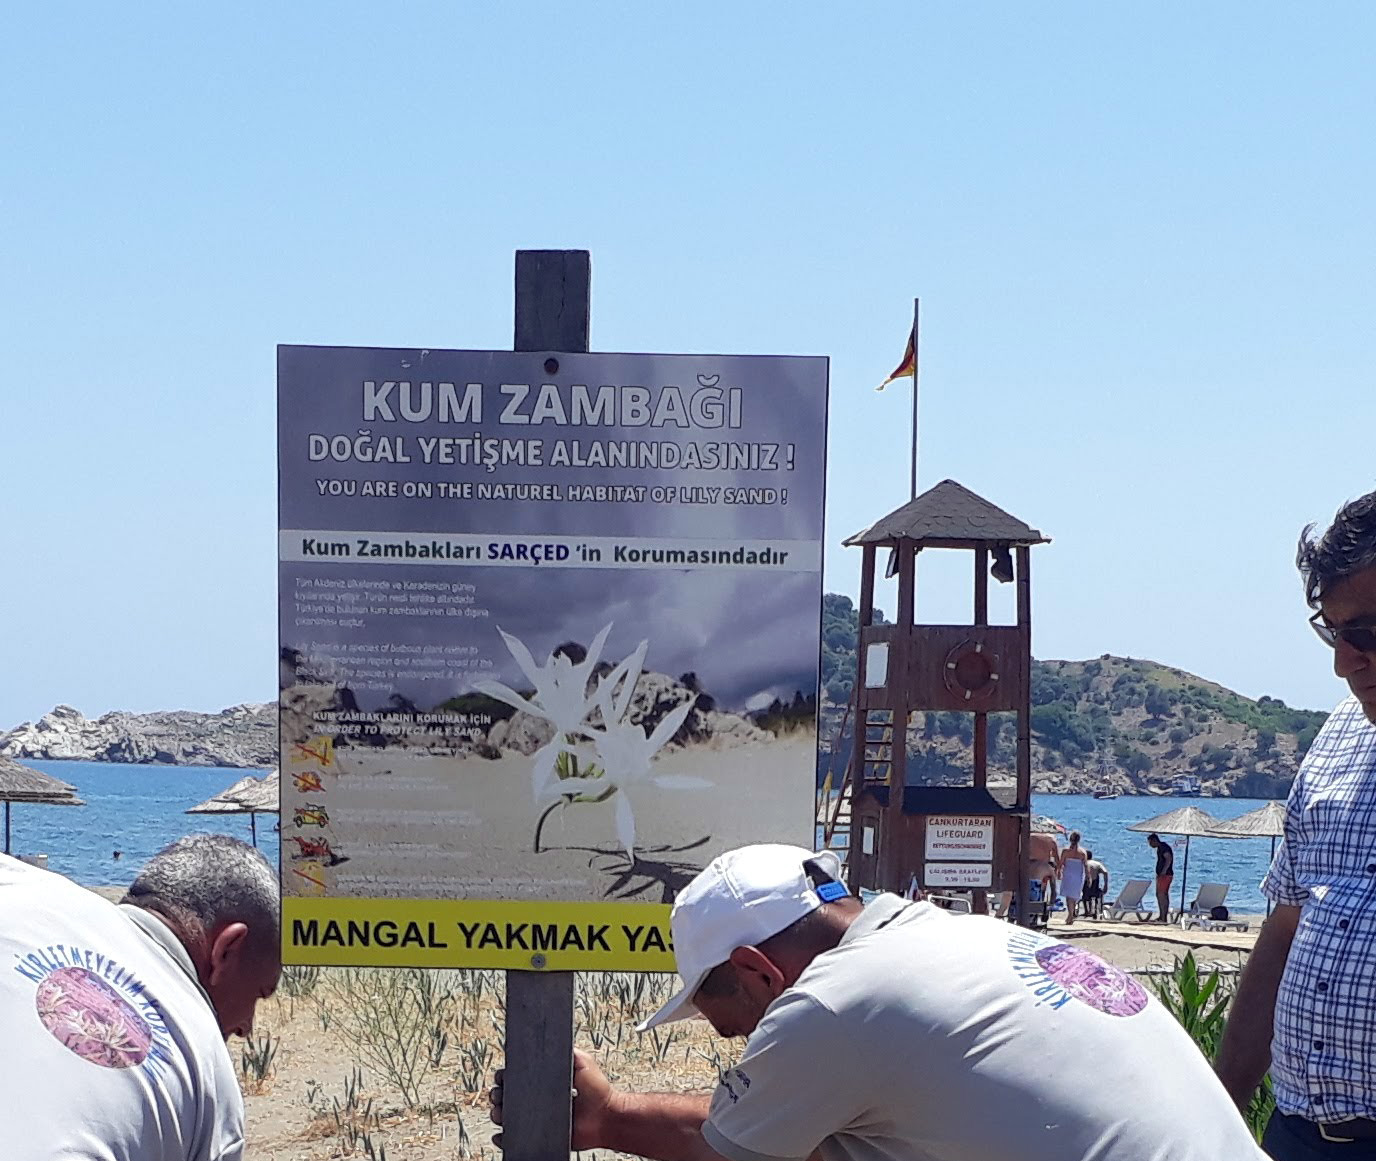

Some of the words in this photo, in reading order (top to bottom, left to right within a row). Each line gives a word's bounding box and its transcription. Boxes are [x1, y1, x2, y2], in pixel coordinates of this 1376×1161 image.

[363, 380, 483, 423] KUM
[499, 374, 743, 428] ZAMBAĞI
[308, 429, 411, 462] DOĞAL
[417, 432, 543, 473] YETİŞME
[549, 439, 780, 470] ALANINDASINIZ
[787, 443, 795, 470] !
[316, 480, 356, 496] YOU
[361, 481, 398, 497] ARE
[402, 482, 433, 498] ON
[437, 483, 472, 499] THE
[477, 483, 563, 500] NATUREL
[567, 485, 647, 502] HABITAT
[650, 486, 676, 503] OF
[679, 486, 721, 504] LILY
[723, 487, 777, 505] SAND
[781, 489, 788, 505] !
[302, 538, 351, 556] Kum
[357, 540, 481, 559] Zambakları
[487, 543, 570, 565] SARÇED
[614, 545, 789, 565] Korumasındadır
[364, 725, 378, 735] TO
[936, 830, 983, 838] LIFEGUARD
[292, 919, 448, 949] MANGAL
[457, 922, 611, 952] YAKMAK
[621, 925, 675, 952] YA
